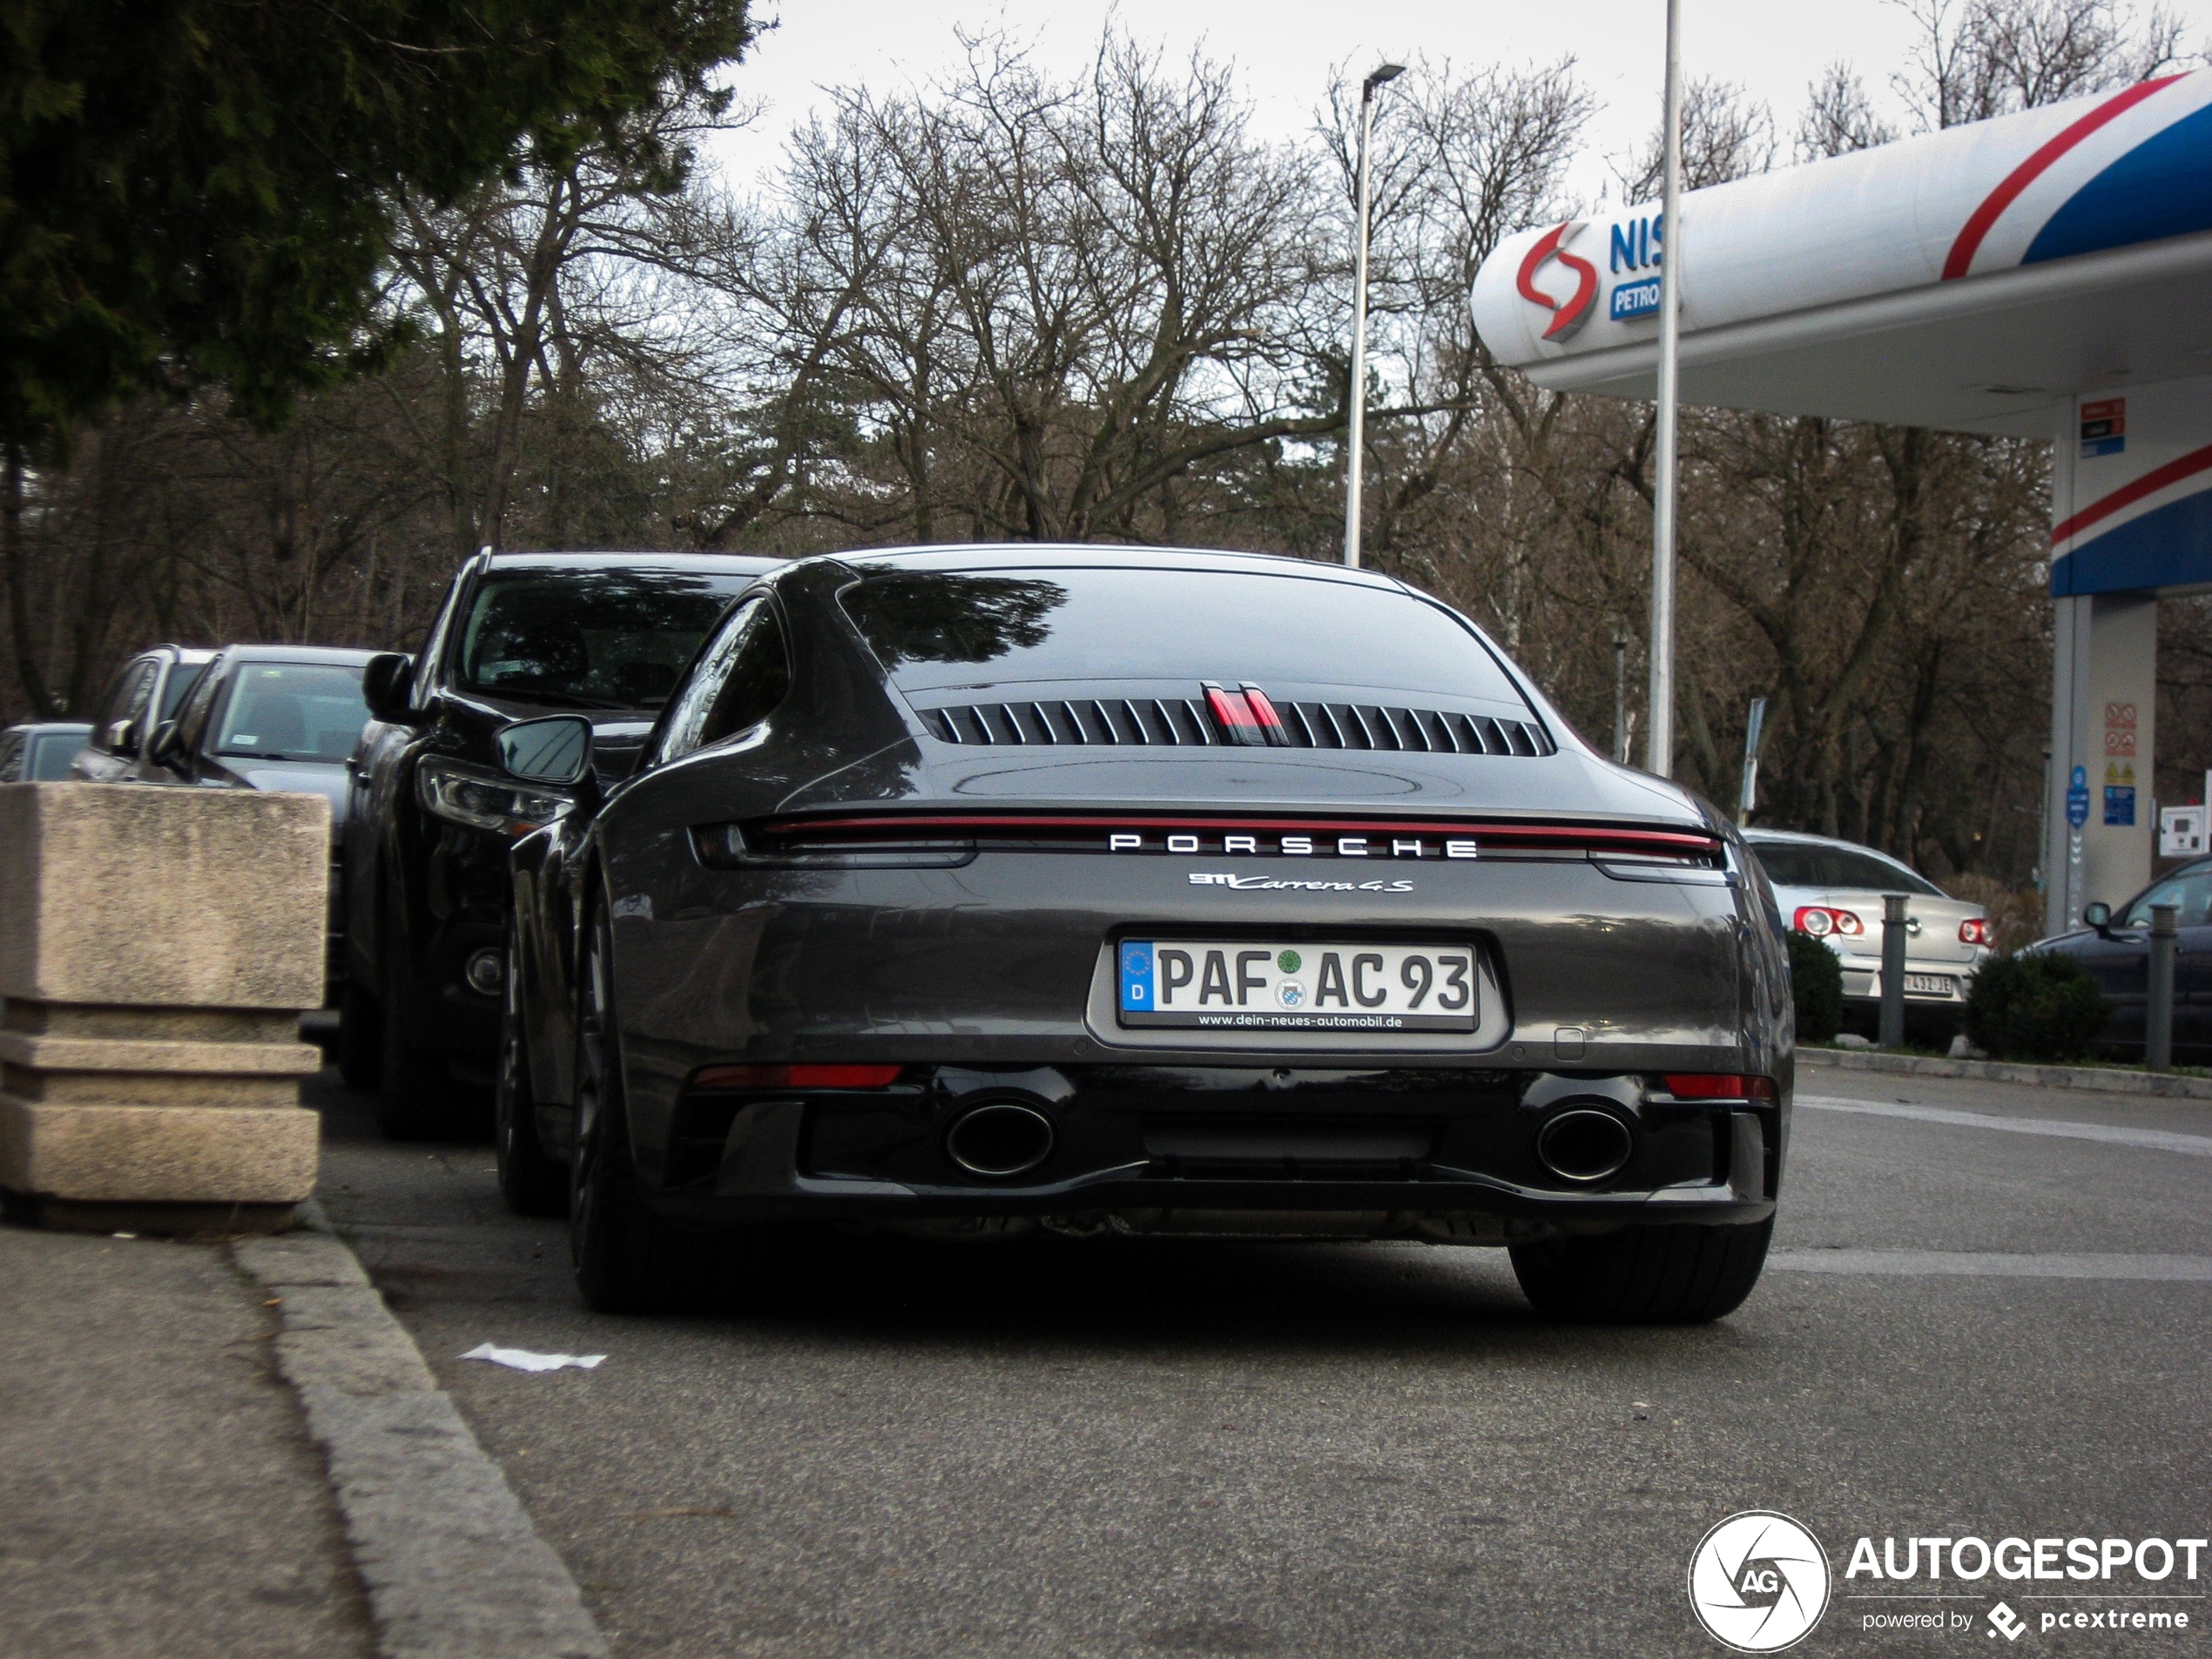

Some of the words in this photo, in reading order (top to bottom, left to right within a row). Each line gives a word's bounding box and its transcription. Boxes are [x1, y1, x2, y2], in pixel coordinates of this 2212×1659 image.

[1615, 283, 1661, 313] PETRO
[1109, 833, 1478, 858] PORSCHE
[1189, 873, 1236, 885] 911
[1229, 876, 1355, 891] Carrera
[1157, 948, 1271, 1006] PAF
[1315, 952, 1386, 1008] AC
[1400, 954, 1469, 1009] 93
[1131, 984, 1145, 1001] D
[1198, 1015, 1403, 1028] www.dein-neues-automobil.de
